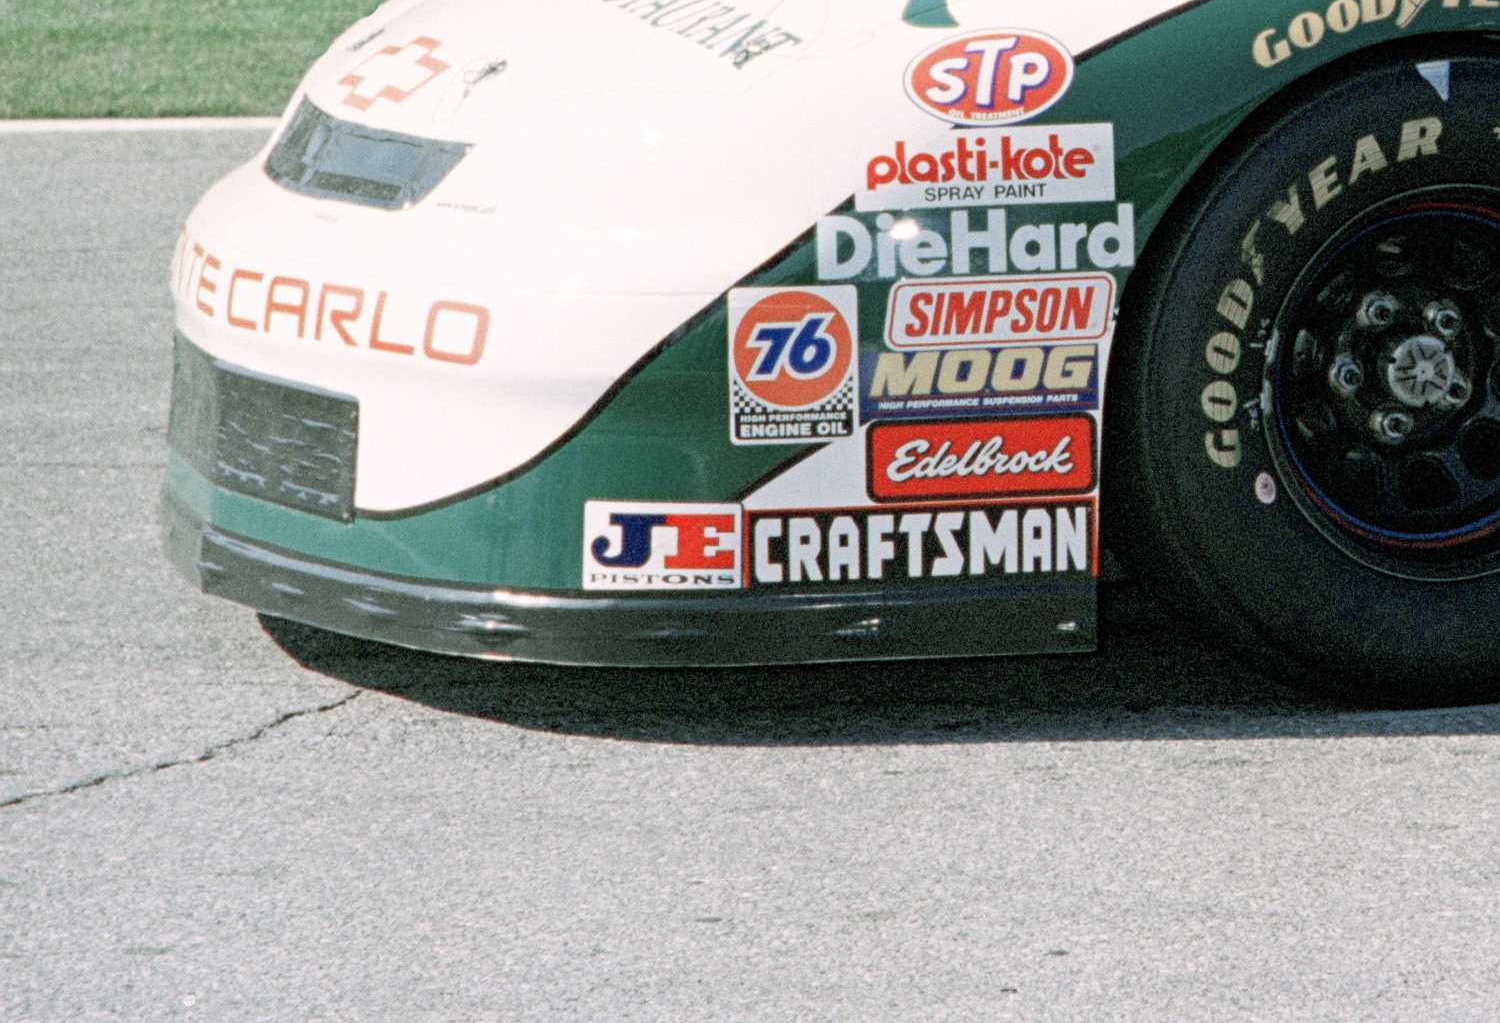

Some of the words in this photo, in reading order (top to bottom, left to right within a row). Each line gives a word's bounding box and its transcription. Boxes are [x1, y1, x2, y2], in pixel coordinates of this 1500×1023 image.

[925, 36, 1050, 108] STP
[866, 134, 1095, 191] plasti-kote
[924, 186, 984, 203] SPRAY
[994, 183, 1047, 199] PAINT
[816, 203, 1136, 281] DieHard
[905, 286, 1094, 338] SIMPSON
[1201, 116, 1444, 468] GOODYEAR
[747, 312, 836, 381] 76
[870, 344, 1095, 397] MOOG
[740, 414, 767, 424] HIGH
[768, 411, 847, 422] PERFORMANCE
[878, 400, 903, 411] HIGH
[906, 397, 979, 410] PERFORMANCE
[982, 395, 1044, 407] SUSPENSION
[1046, 393, 1079, 404] PARTS
[740, 423, 812, 438] ENGINE
[816, 421, 848, 436] OIL
[886, 434, 1074, 482] Edelbrock
[591, 512, 736, 570] JE
[752, 505, 1089, 584] CRAFTSMAN
[591, 573, 736, 585] PISTONS
